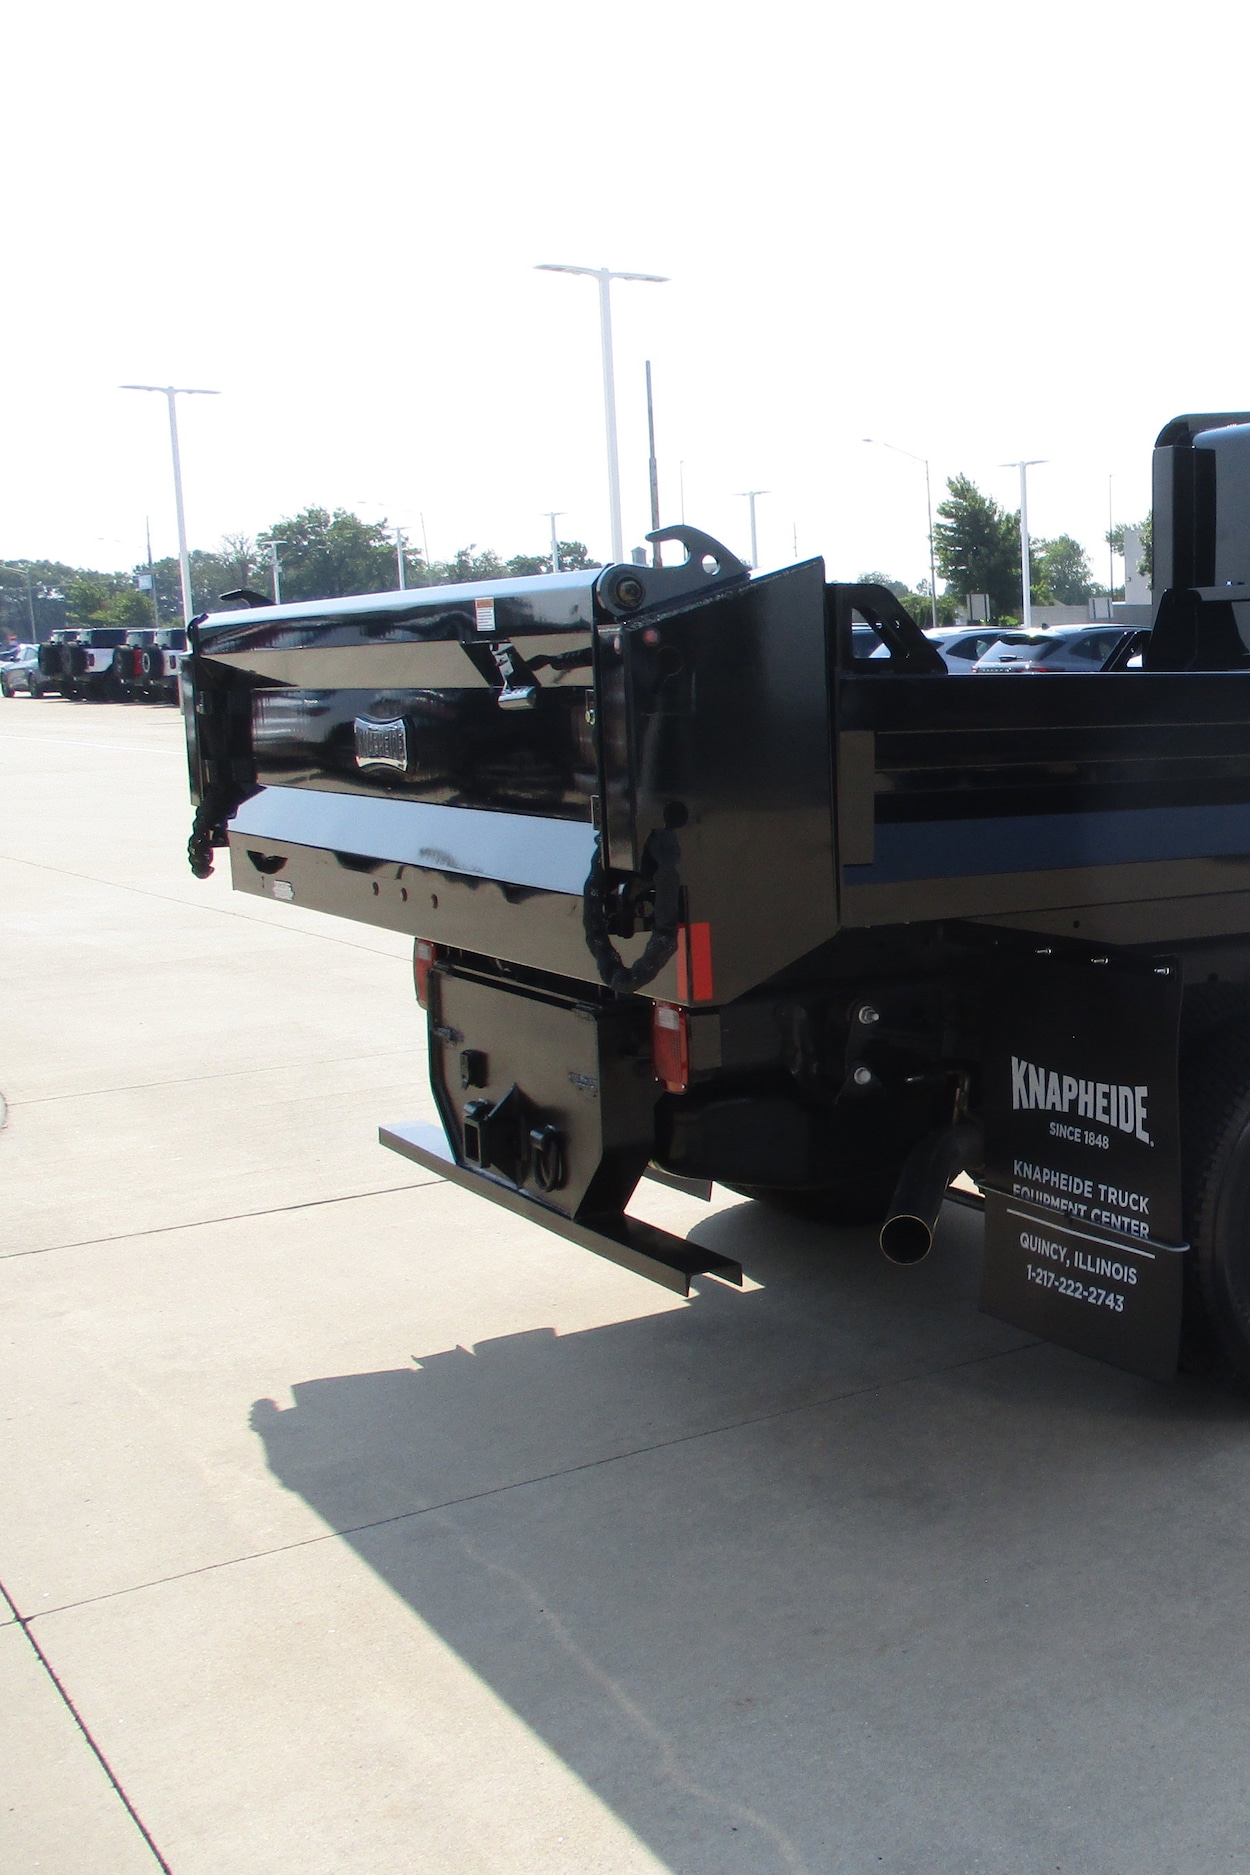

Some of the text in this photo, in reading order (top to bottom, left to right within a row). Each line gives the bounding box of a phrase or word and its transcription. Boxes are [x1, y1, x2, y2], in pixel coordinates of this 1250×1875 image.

[1011, 1055, 1150, 1145] KNAPHEIDE
[1049, 1121, 1110, 1150] SINCE 1848
[1013, 1159, 1150, 1214] KNAPHEIDE TRUCK
[1090, 1208, 1150, 1239] CENTER
[1019, 1231, 1138, 1285] QUINCY, ILLINOIS
[1026, 1264, 1125, 1312] 1-217-222-2743
